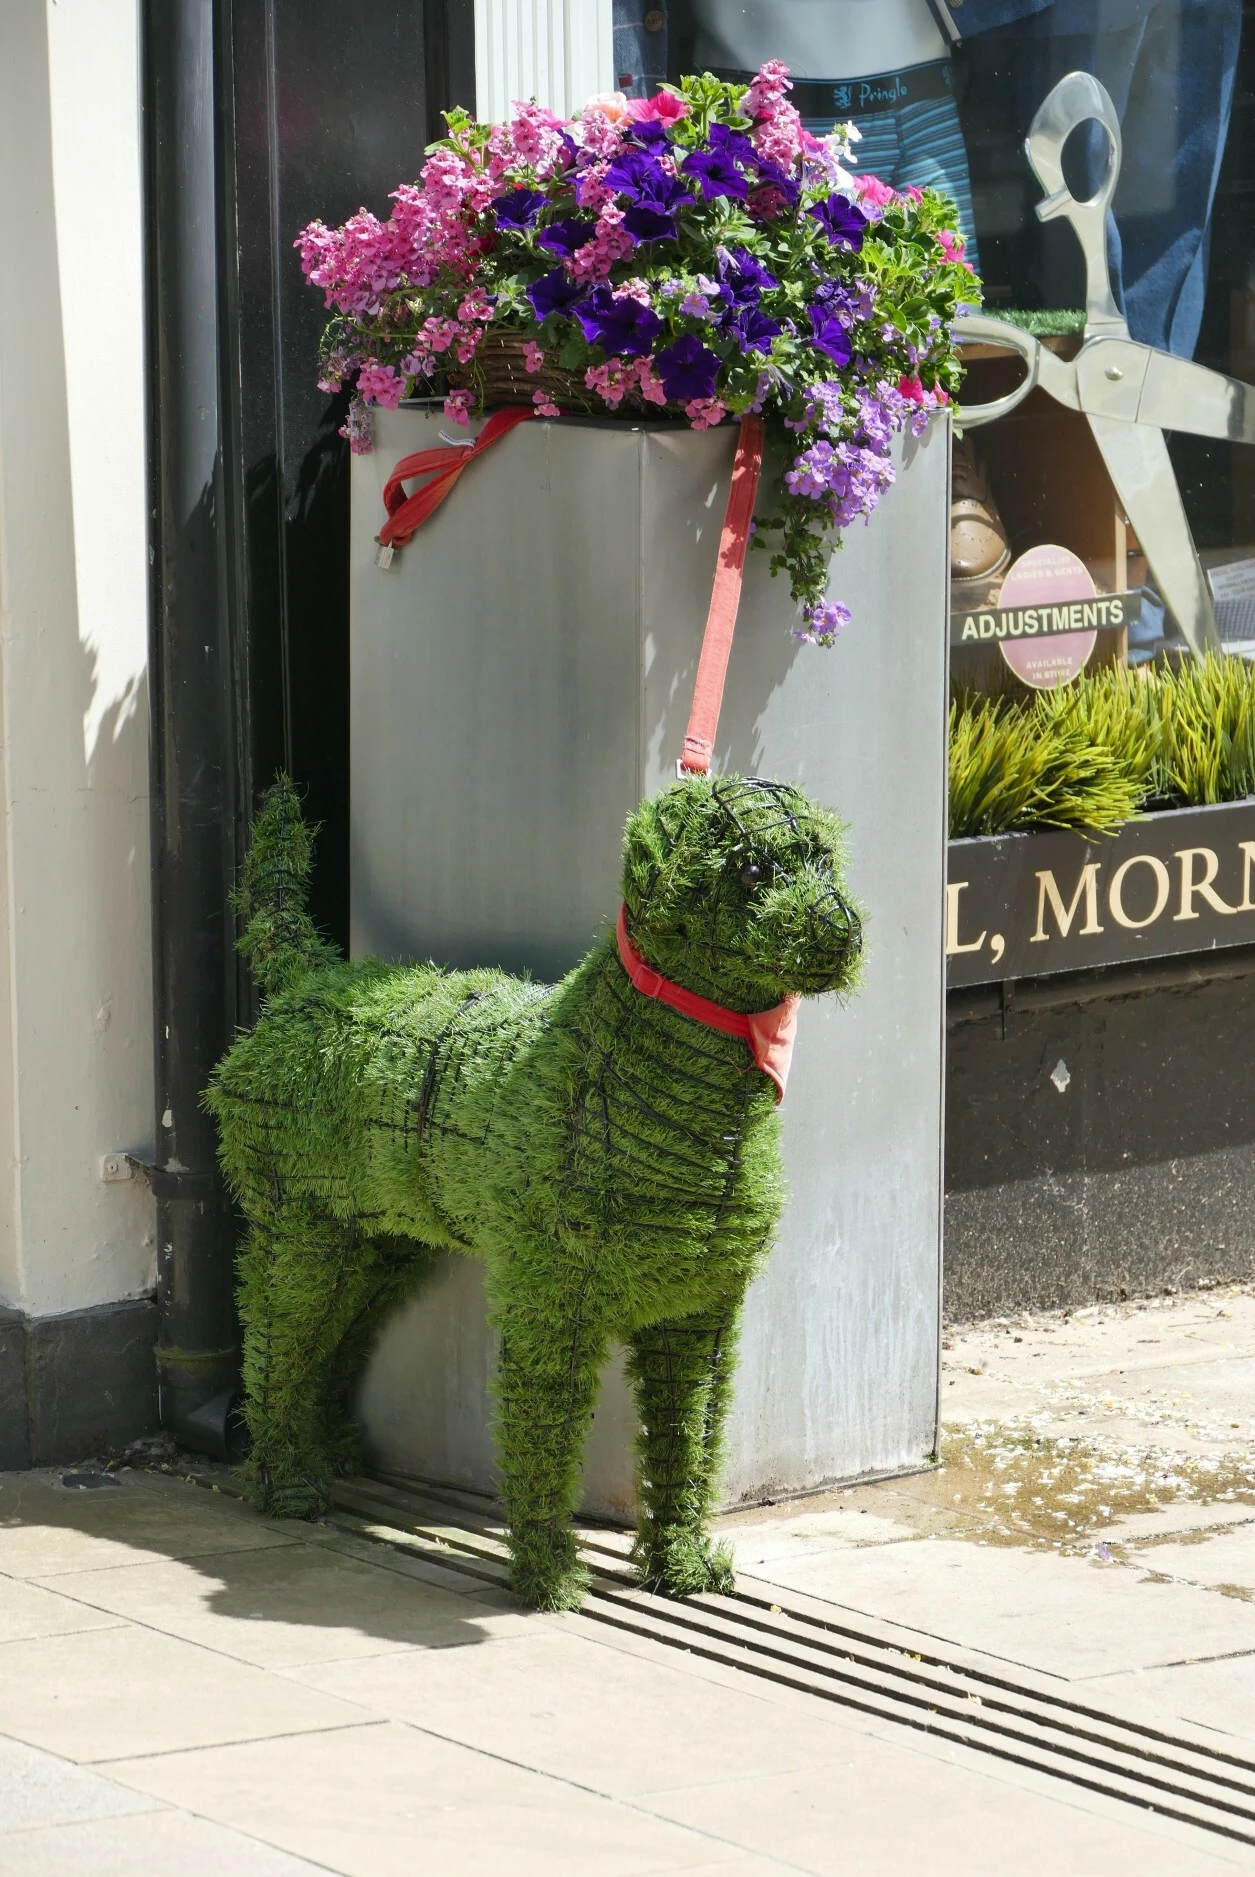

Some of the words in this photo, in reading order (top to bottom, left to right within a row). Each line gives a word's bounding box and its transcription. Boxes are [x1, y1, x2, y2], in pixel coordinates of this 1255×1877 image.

[859, 77, 908, 107] Pringle
[961, 599, 1124, 641] ADJUSTMENTS
[1026, 656, 1073, 669] AVAILABLE
[1030, 841, 1255, 943] MOR
